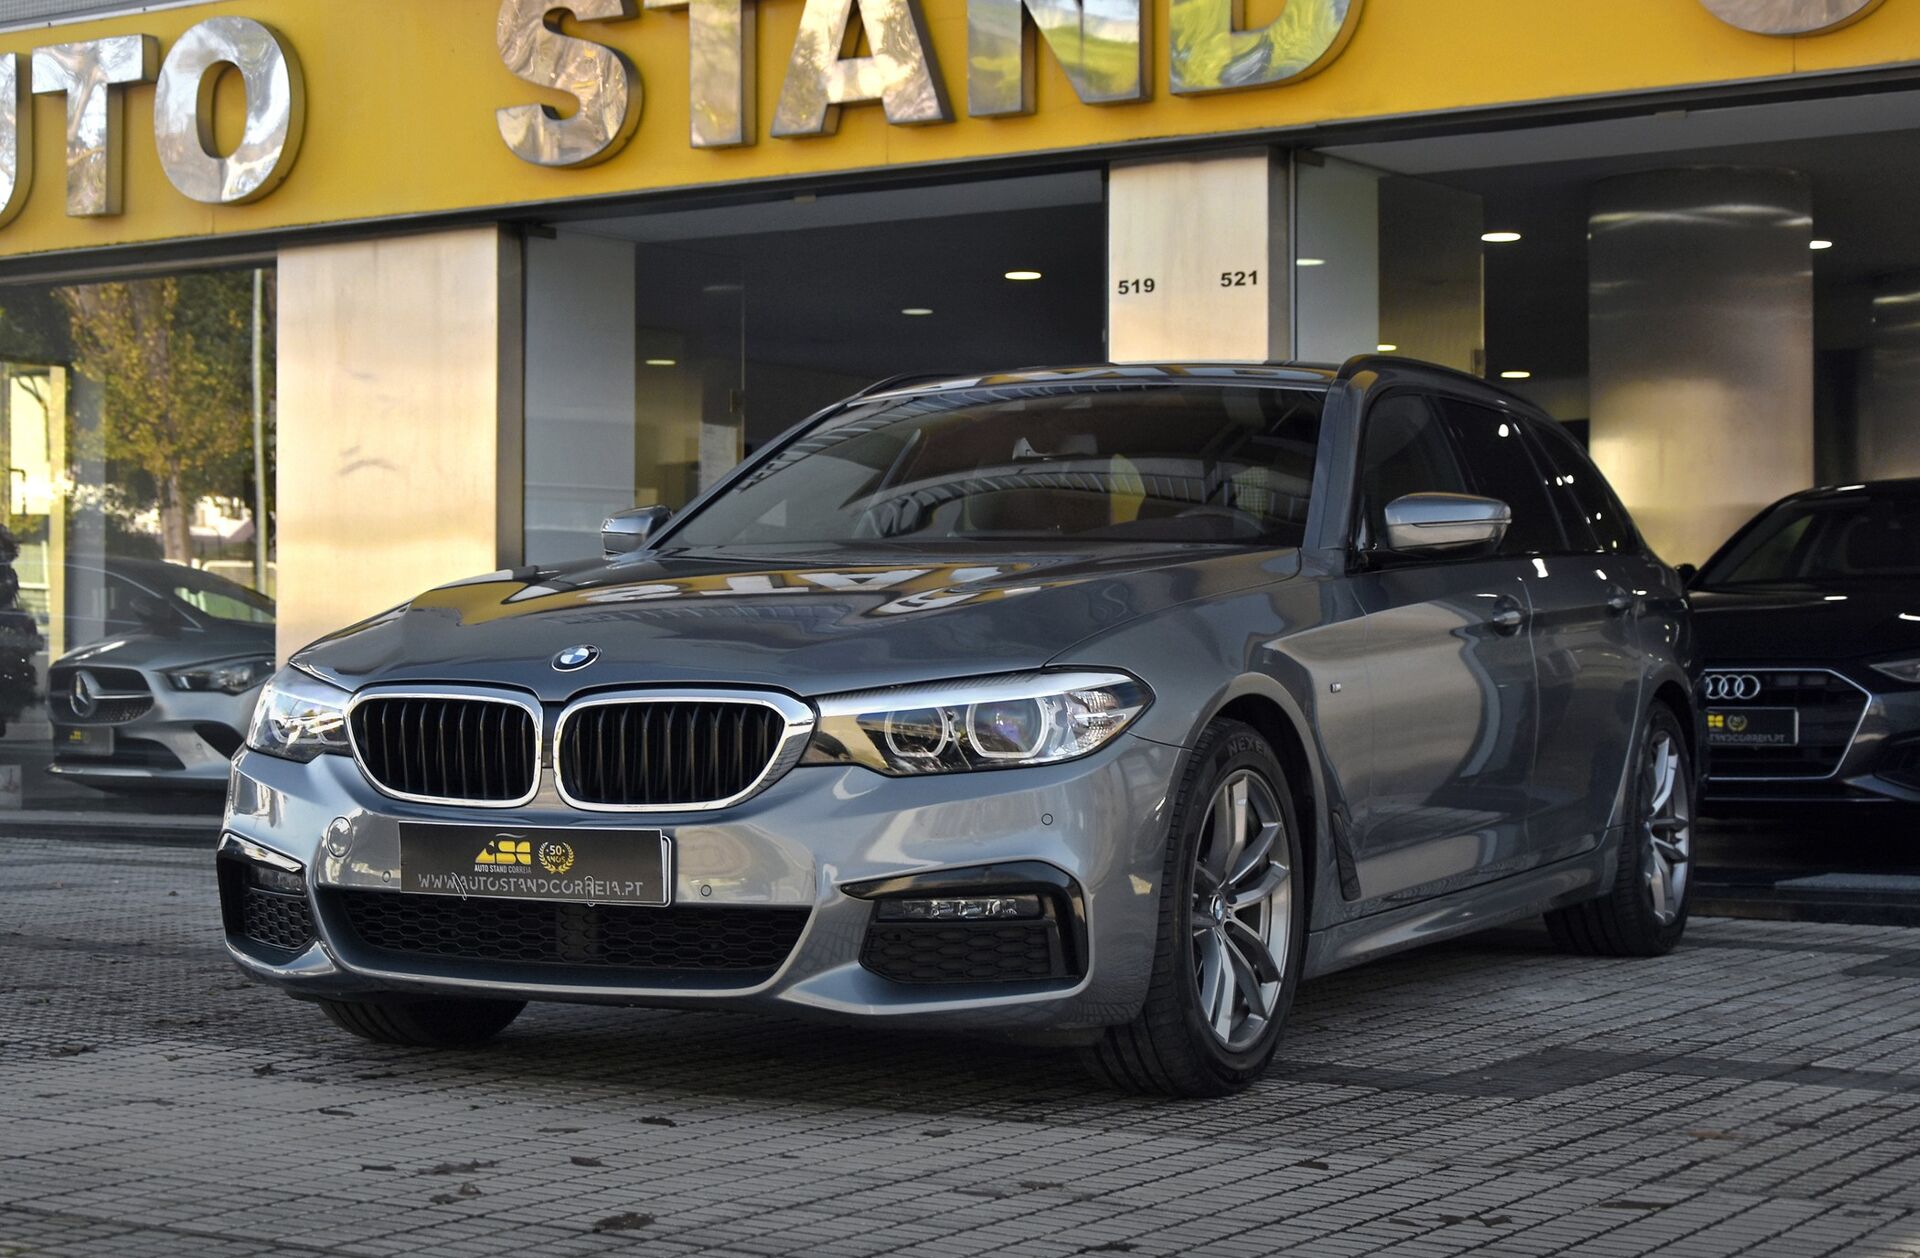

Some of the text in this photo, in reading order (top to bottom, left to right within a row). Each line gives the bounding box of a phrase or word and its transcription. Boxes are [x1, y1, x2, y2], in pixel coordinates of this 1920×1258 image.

[0, 16, 305, 228] TO
[1118, 278, 1155, 294] 519
[1221, 270, 1258, 287] 521
[549, 845, 562, 856] 50
[474, 864, 532, 874] AUTO STAND CORREIA
